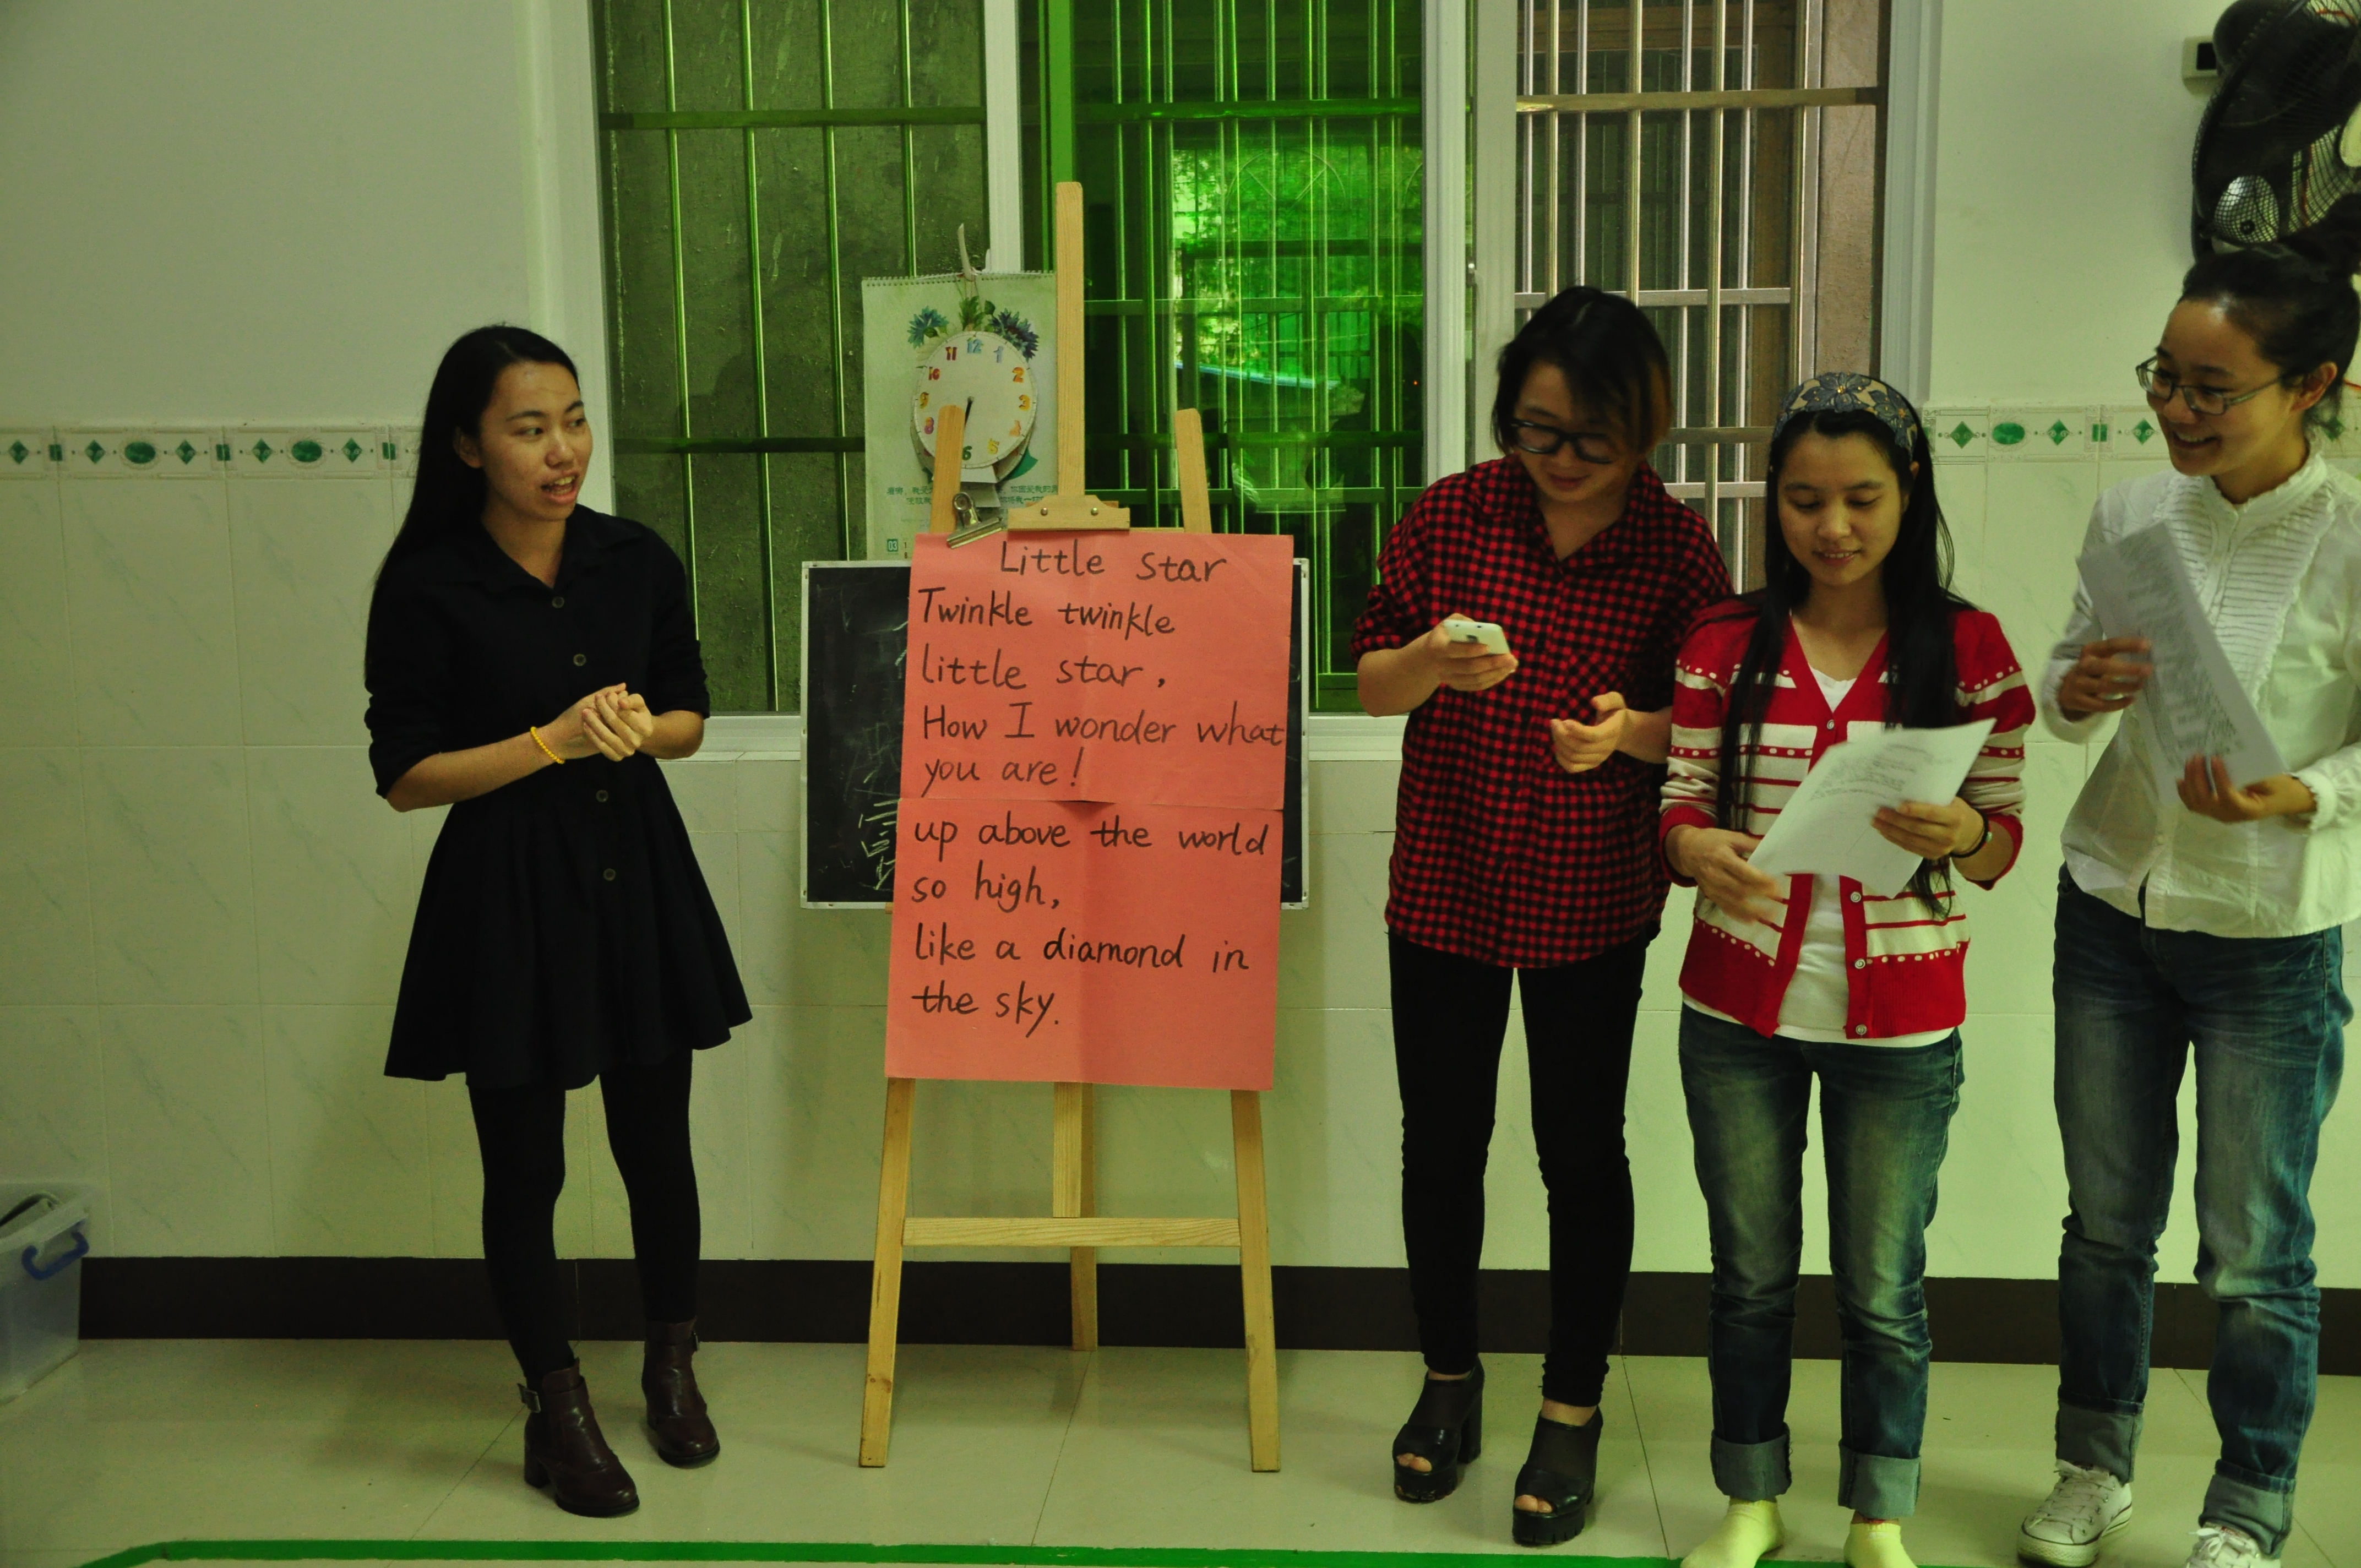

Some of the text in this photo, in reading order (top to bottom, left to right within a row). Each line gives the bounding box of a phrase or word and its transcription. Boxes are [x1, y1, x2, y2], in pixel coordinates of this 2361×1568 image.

[945, 346, 958, 361] 11
[967, 337, 982, 353] 12
[994, 346, 1004, 363] 1
[928, 366, 940, 380] 10
[1012, 367, 1025, 383] 2
[920, 392, 929, 409] 9
[1019, 394, 1030, 410] 3
[924, 417, 934, 434] 8
[962, 445, 972, 460] 6
[987, 438, 1000, 454] 5
[888, 541, 897, 551] 03
[1001, 538, 1105, 576] Little
[918, 586, 1175, 640] Twinkle twinkle
[922, 643, 1026, 690] little
[924, 701, 1285, 746] How I wonder what
[921, 759, 980, 798] you
[915, 810, 1269, 862] up above the world
[912, 859, 1059, 913] so high,
[916, 922, 1249, 973] like a diamond in
[911, 980, 1059, 1038] the sky.
